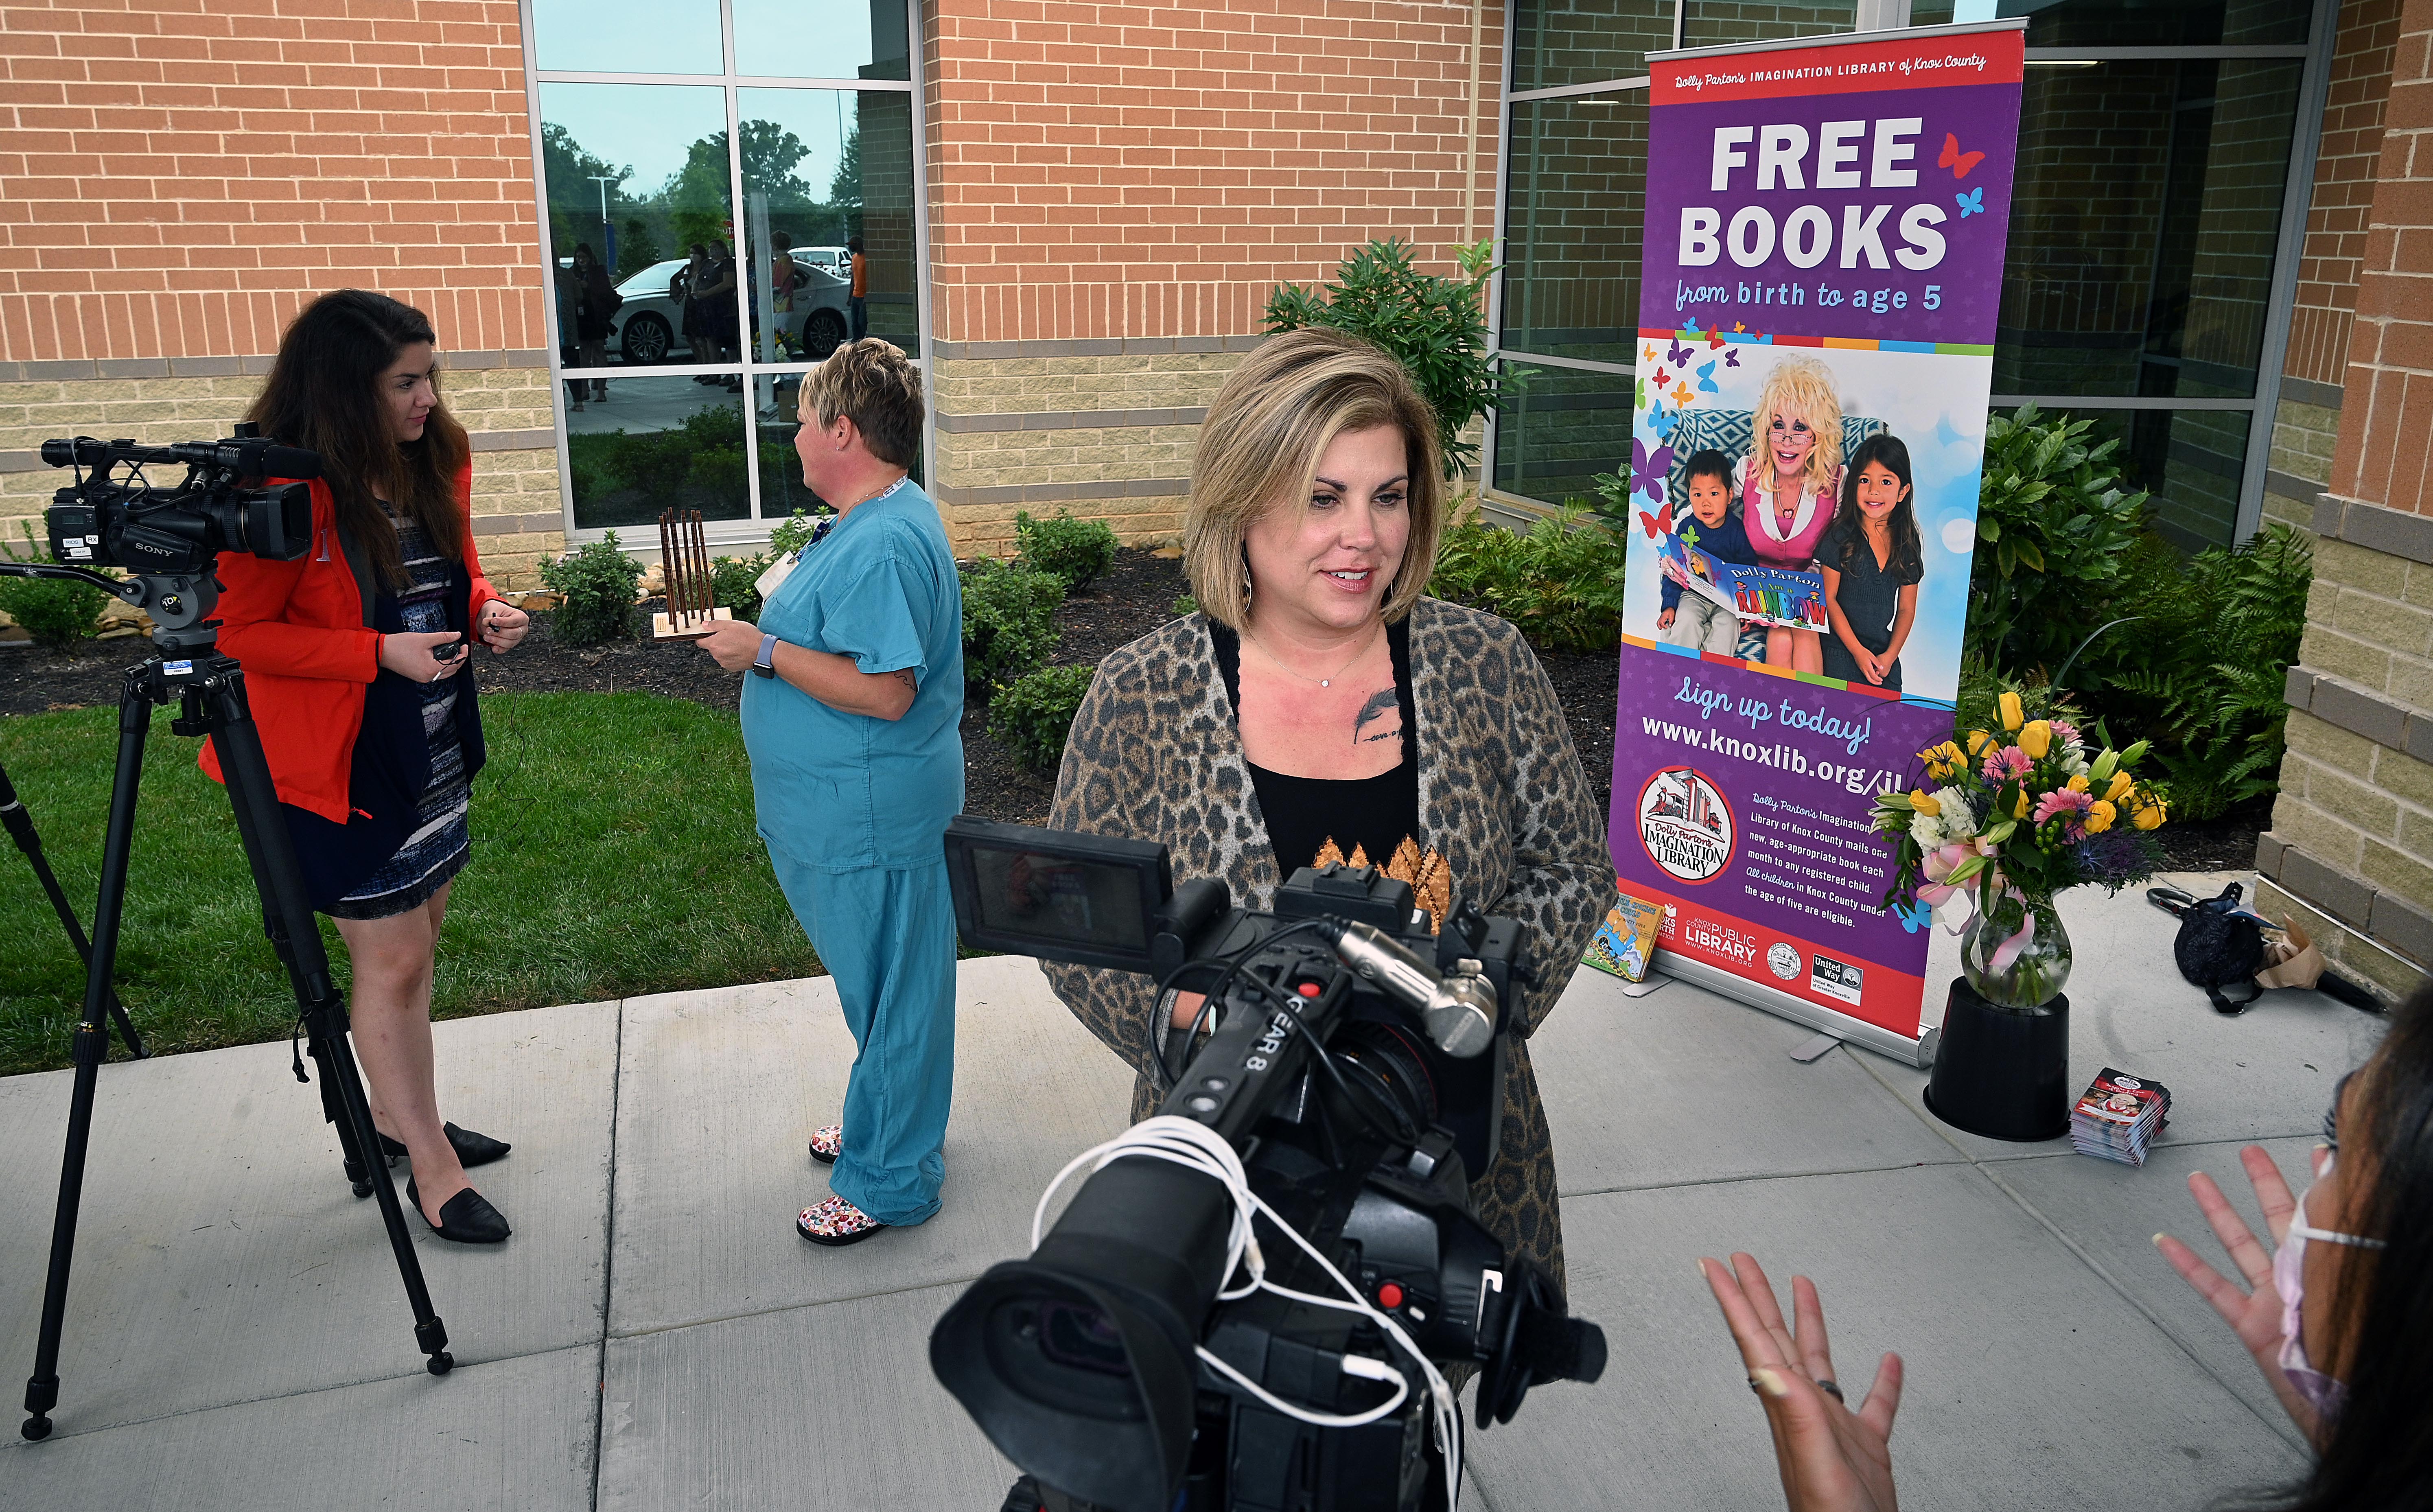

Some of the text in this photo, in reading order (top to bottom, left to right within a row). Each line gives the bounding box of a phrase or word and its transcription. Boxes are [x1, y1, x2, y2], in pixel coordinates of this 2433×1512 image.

[1676, 53, 1987, 91] Dolly Parton's IMAGINATION LIBRARY of Knox County
[1711, 117, 1923, 191] FREE
[1678, 203, 1947, 271] BOOKS
[1676, 280, 1941, 313] from birth to age 5
[136, 543, 173, 557] SONY
[1731, 567, 1820, 589] Dolly Parton
[1735, 590, 1827, 626] RAINBOW
[1675, 676, 1871, 755] Sign up today!
[1753, 792, 1870, 833] Dolly Parton's Imagination
[1645, 823, 1724, 866] IMAGINATION
[1655, 823, 1677, 836] Dolly
[1751, 812, 1888, 859] Library of Knox County mails one
[1657, 846, 1709, 877] LIBRARY
[1749, 831, 1884, 878] new, age-appropriate book each
[1748, 850, 1873, 894] month to any registered child.
[1620, 906, 1641, 918] COULD
[1631, 902, 1656, 915] ENGINE
[1745, 884, 1855, 928] the age of five are eligible.
[1761, 873, 1795, 889] children
[1796, 881, 1804, 892] in
[1806, 884, 1827, 899] Knox
[1829, 892, 1858, 911] County
[1861, 902, 1886, 918] under
[1686, 920, 1711, 932] COUNTY
[1694, 917, 1711, 926] KNOX
[1711, 923, 1755, 947] PUBLIC
[1685, 926, 1757, 961] LIBRARY
[1685, 940, 1752, 967] WWW.KNOXLIB.ORG
[1815, 957, 1840, 973] United
[1824, 968, 1840, 982] Way
[1817, 985, 1831, 993] Greater
[1832, 990, 1850, 1000] Knoxville
